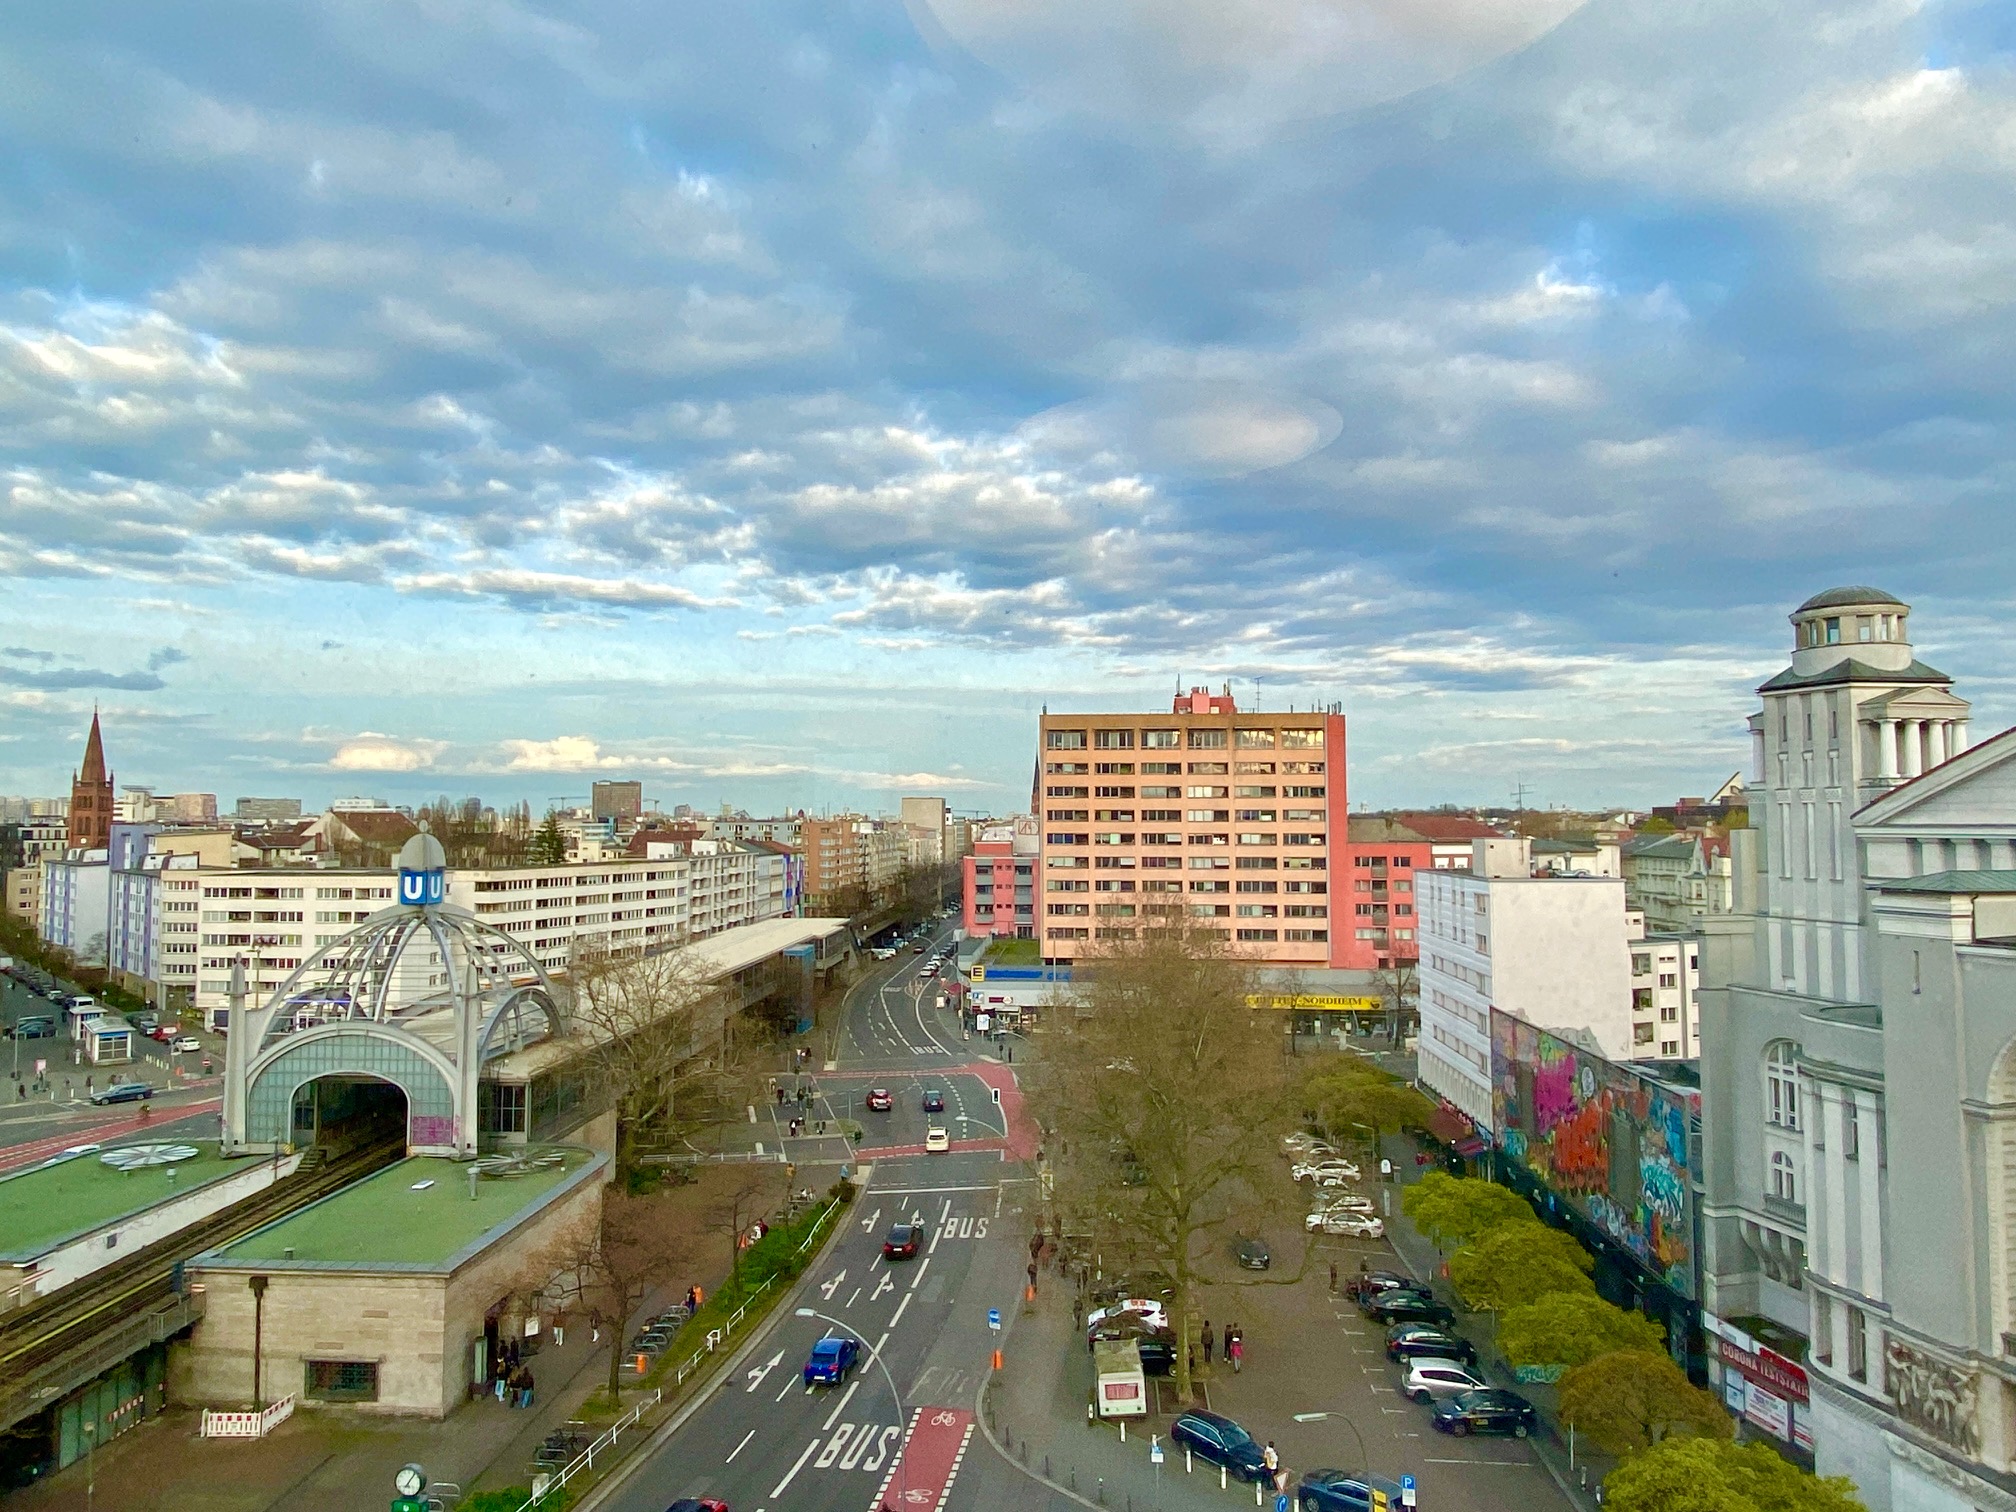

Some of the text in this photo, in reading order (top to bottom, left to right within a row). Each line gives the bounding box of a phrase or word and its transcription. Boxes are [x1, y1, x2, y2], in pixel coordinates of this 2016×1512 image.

[404, 876, 423, 900] U
[430, 876, 441, 899] U
[943, 1217, 990, 1239] BUS
[1721, 1342, 1758, 1372] CORONA
[813, 1422, 901, 1472] BUS
[1405, 1478, 1412, 1488] P
